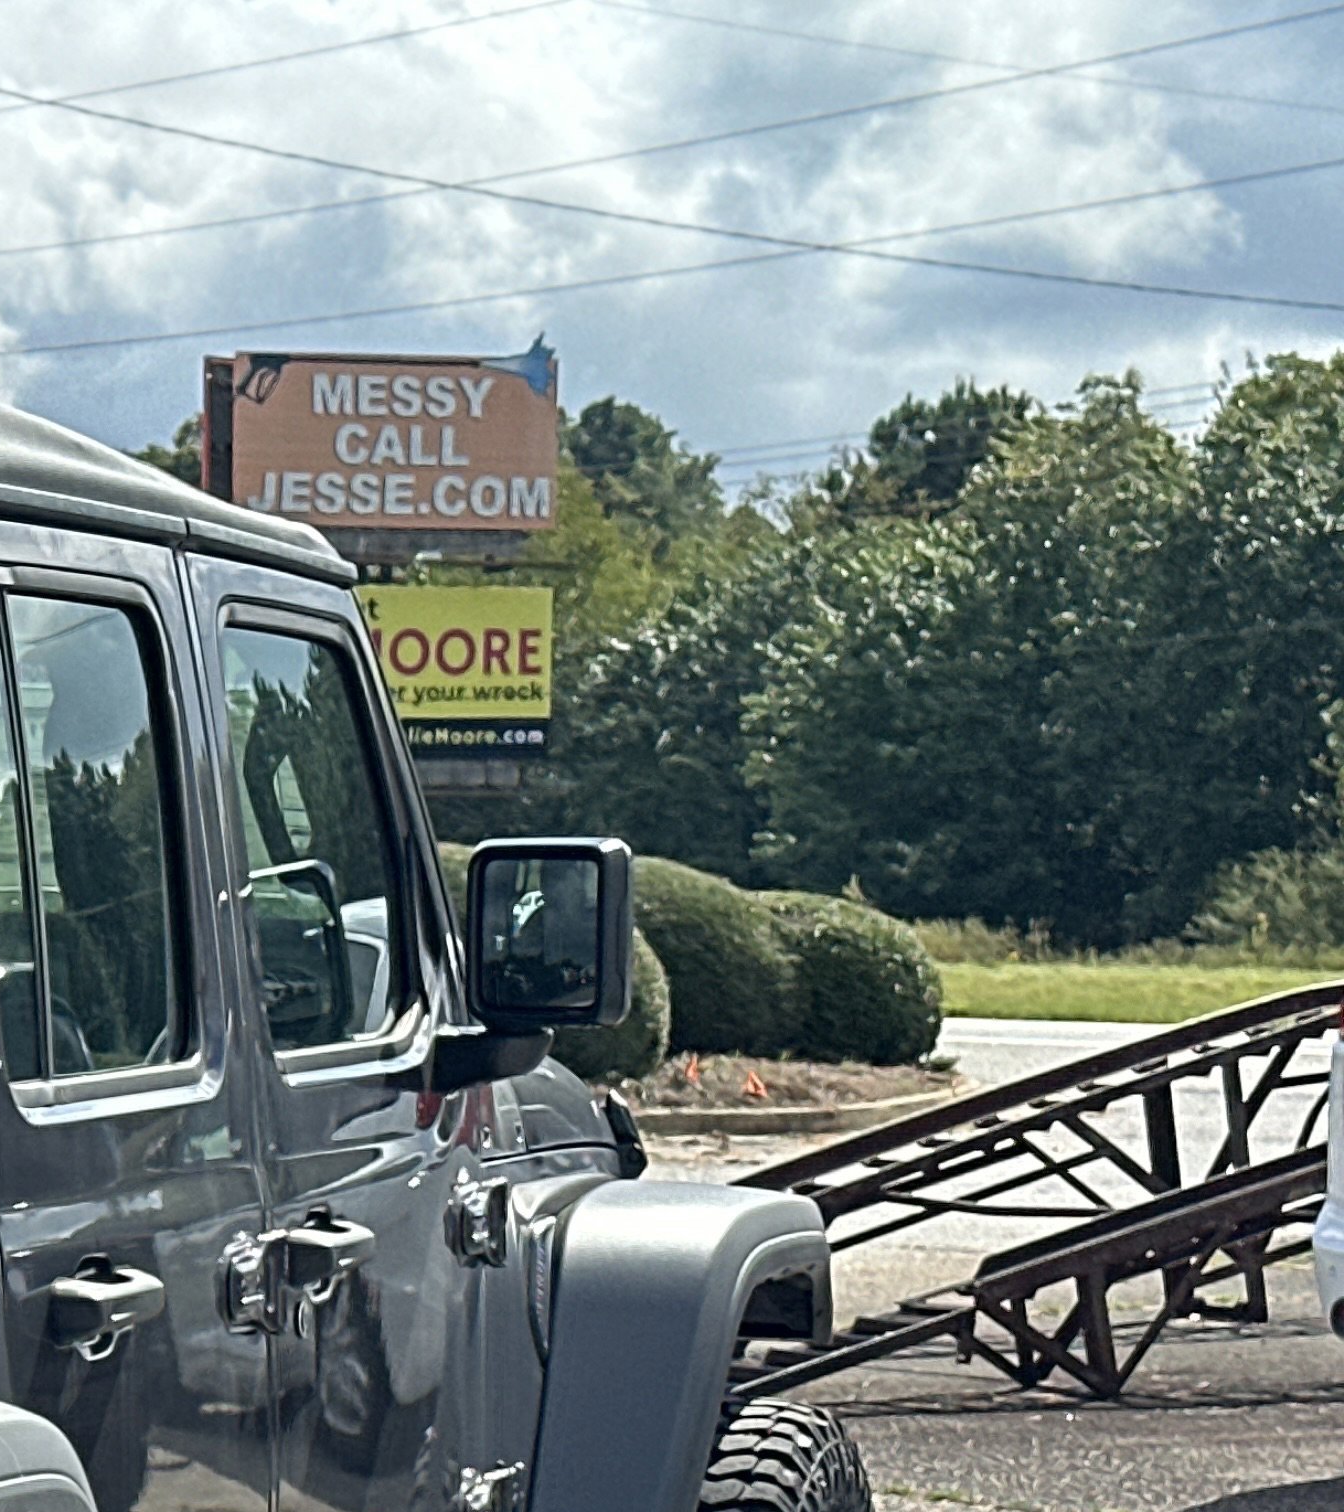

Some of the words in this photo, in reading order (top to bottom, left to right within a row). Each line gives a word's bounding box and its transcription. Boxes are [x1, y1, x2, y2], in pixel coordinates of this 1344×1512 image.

[312, 373, 496, 418] MESSY
[334, 424, 470, 466] CALL
[247, 471, 552, 518] JESSE.COM
[413, 685, 467, 707] your
[473, 680, 544, 702] wreck
